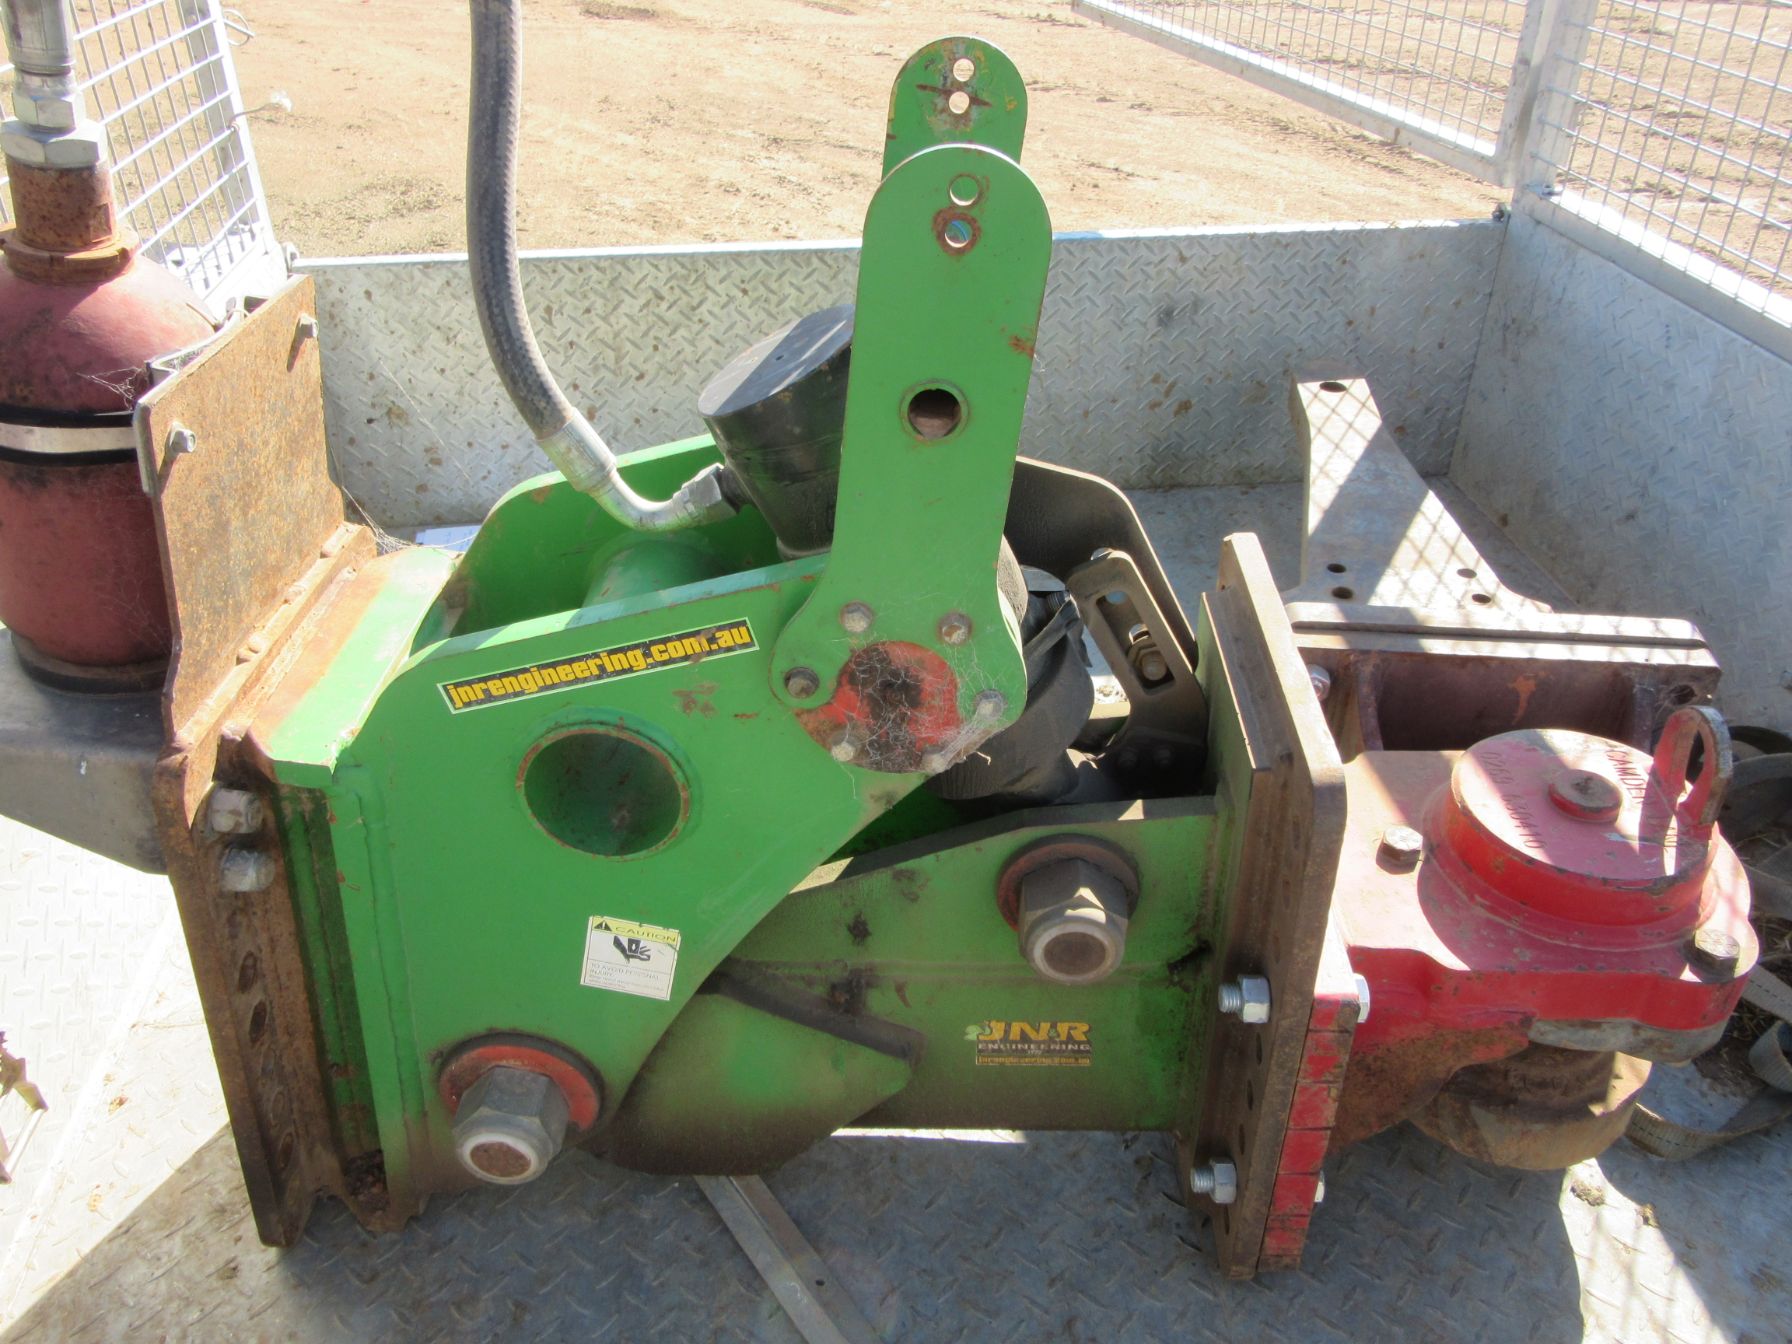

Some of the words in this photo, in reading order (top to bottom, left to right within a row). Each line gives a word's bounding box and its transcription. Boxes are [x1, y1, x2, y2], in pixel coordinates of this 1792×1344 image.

[447, 625, 751, 709] jnrengineering.com.au
[615, 926, 676, 943] CAUTION
[978, 1042, 1091, 1051] ENGINEERING
